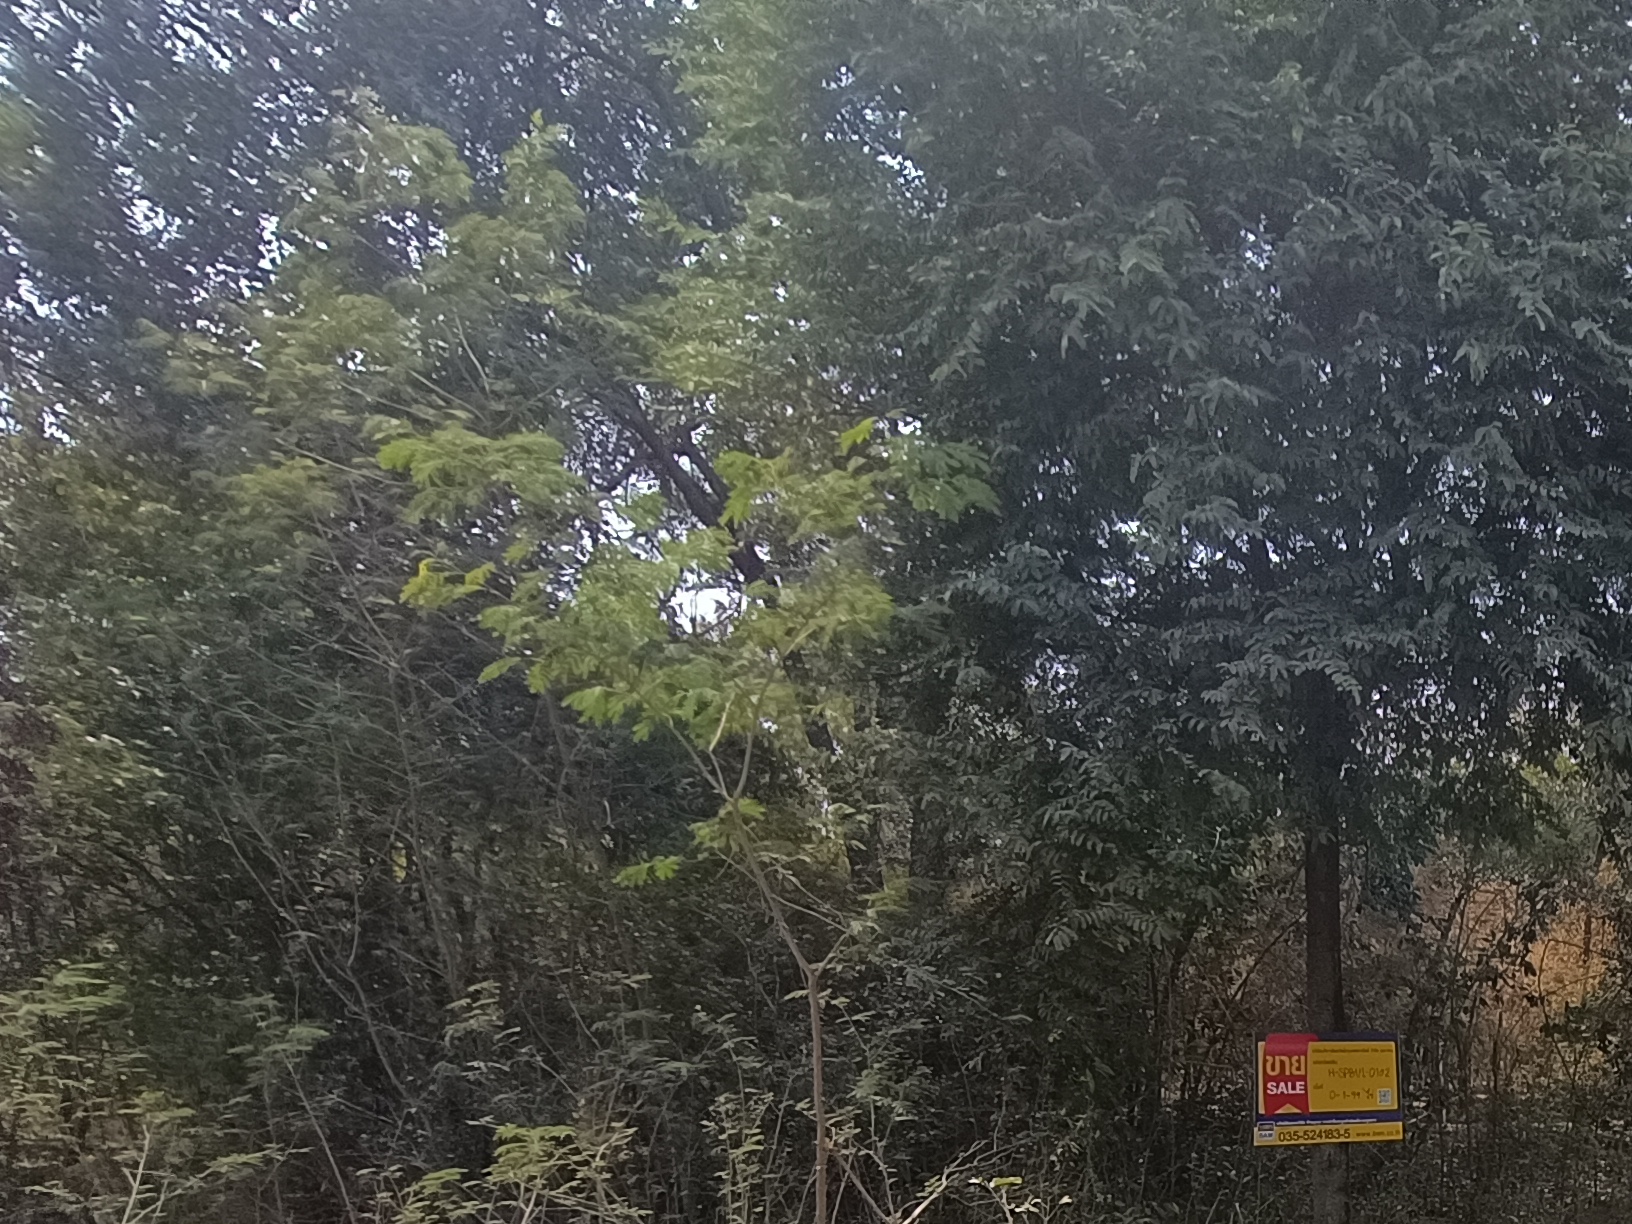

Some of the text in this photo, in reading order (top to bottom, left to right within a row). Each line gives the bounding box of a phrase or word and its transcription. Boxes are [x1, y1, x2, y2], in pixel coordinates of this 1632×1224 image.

[1266, 1055, 1305, 1076] ขาย
[1266, 1081, 1305, 1095] SALE
[1278, 1128, 1350, 1143] 035-524183-5
